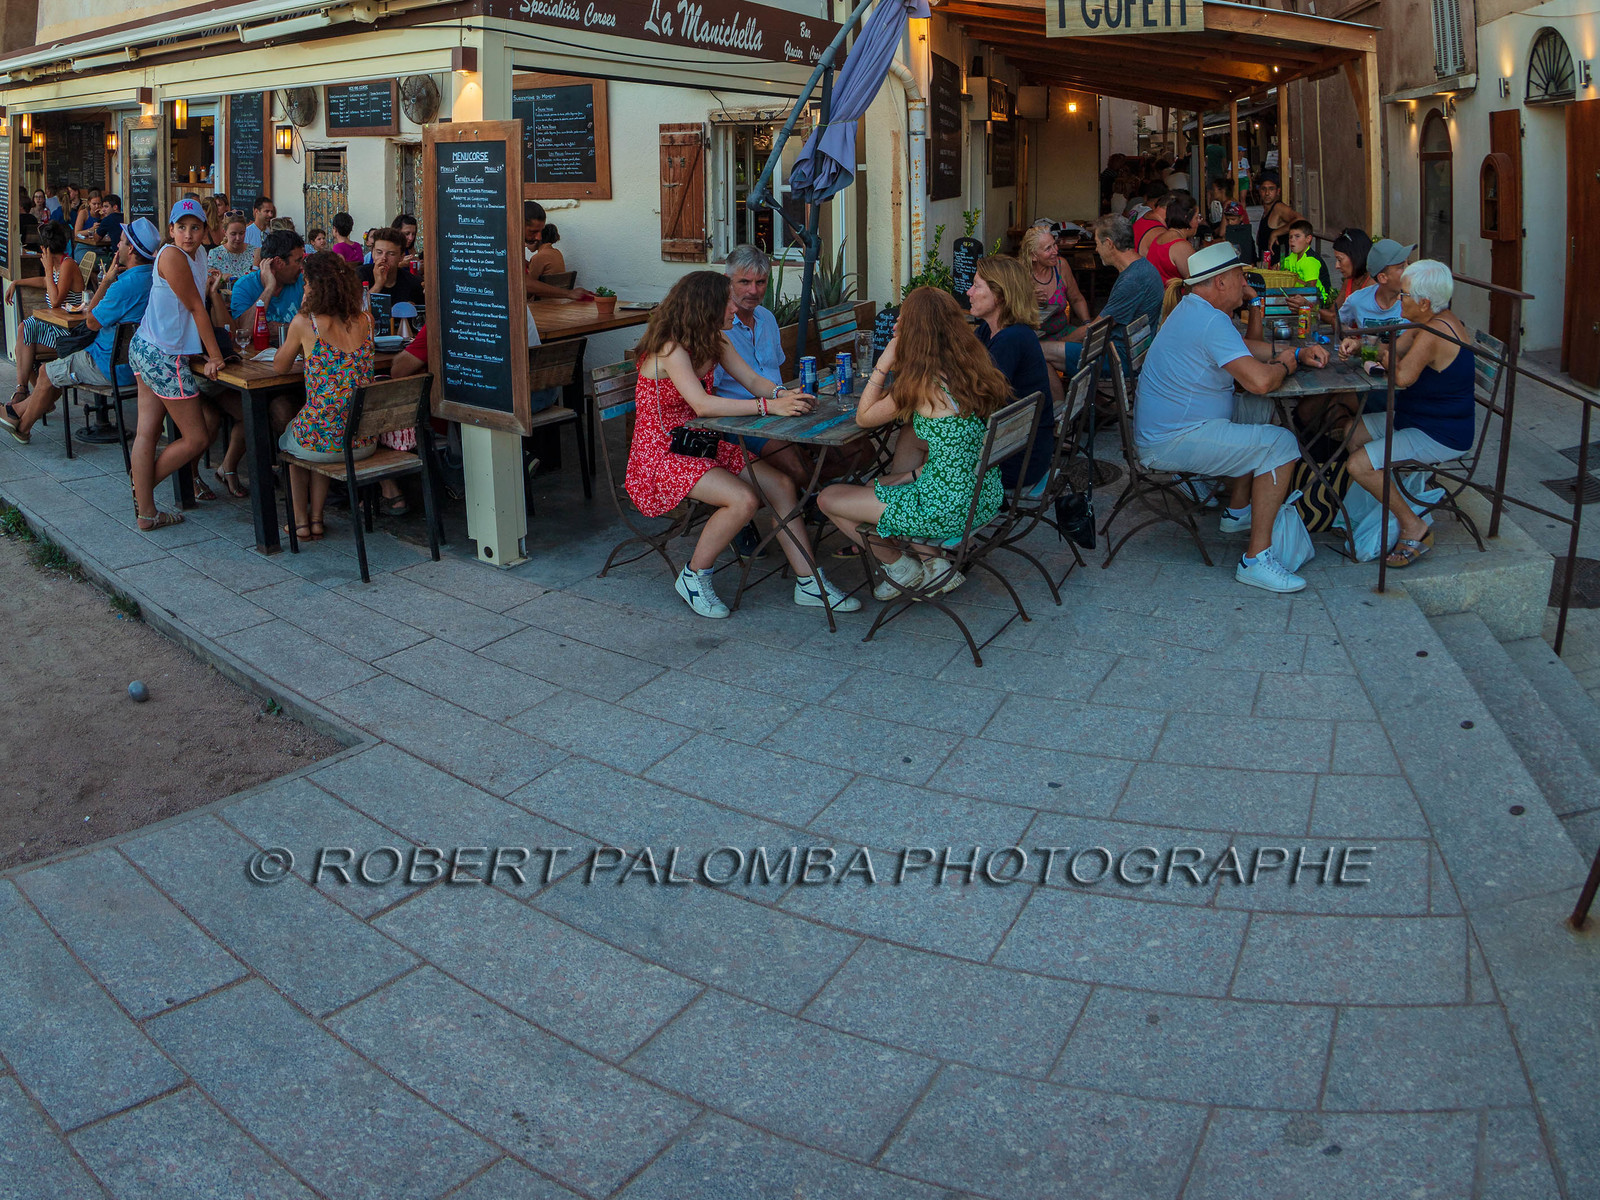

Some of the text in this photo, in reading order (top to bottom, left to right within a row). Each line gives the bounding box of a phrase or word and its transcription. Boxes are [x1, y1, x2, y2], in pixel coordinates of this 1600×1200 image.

[583, 2, 617, 27] Corses
[800, 21, 811, 39] Bar
[784, 39, 804, 61] Glacier
